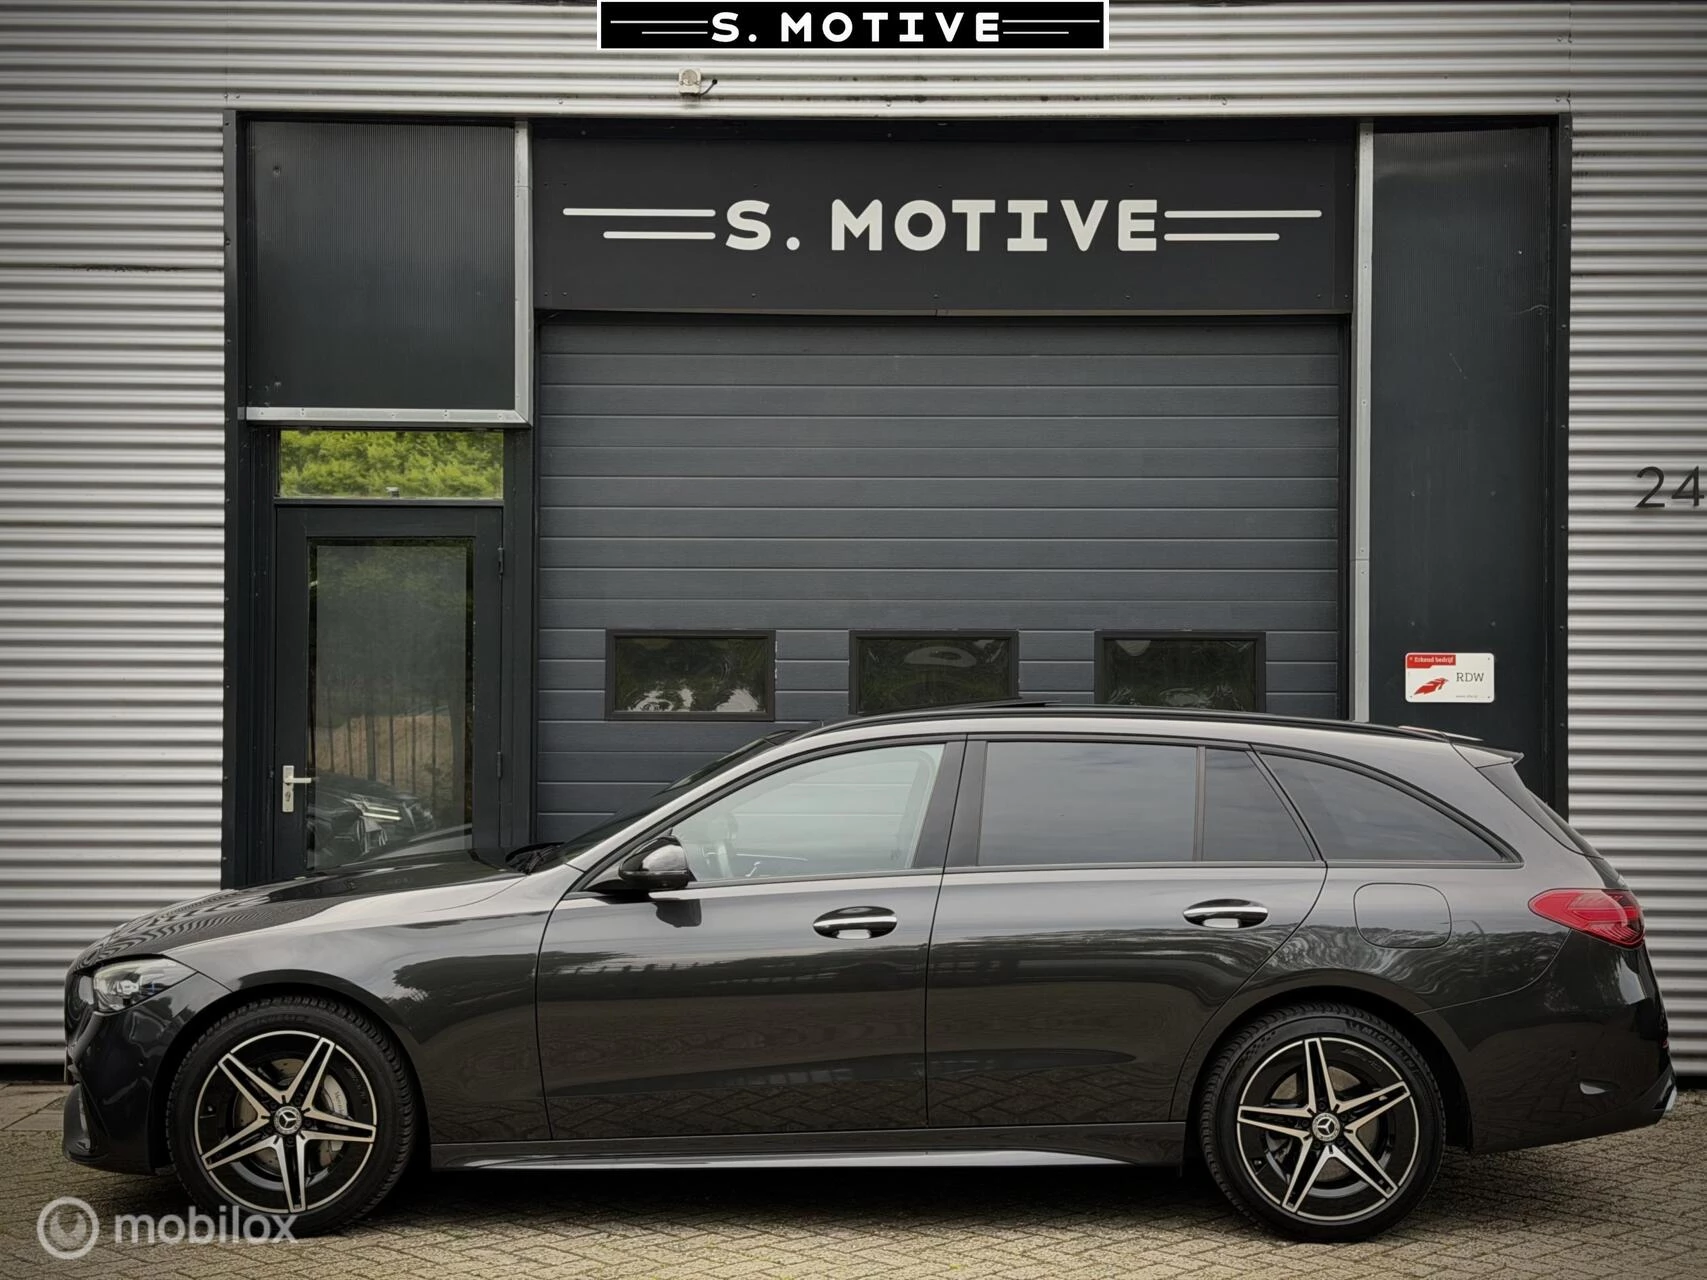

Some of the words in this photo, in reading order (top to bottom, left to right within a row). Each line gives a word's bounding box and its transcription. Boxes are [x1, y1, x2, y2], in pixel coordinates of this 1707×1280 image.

[725, 199, 800, 251] S.
[831, 199, 1157, 251] MOTIVE
[1635, 466, 1705, 508] 24
[1456, 672, 1484, 682] RDW
